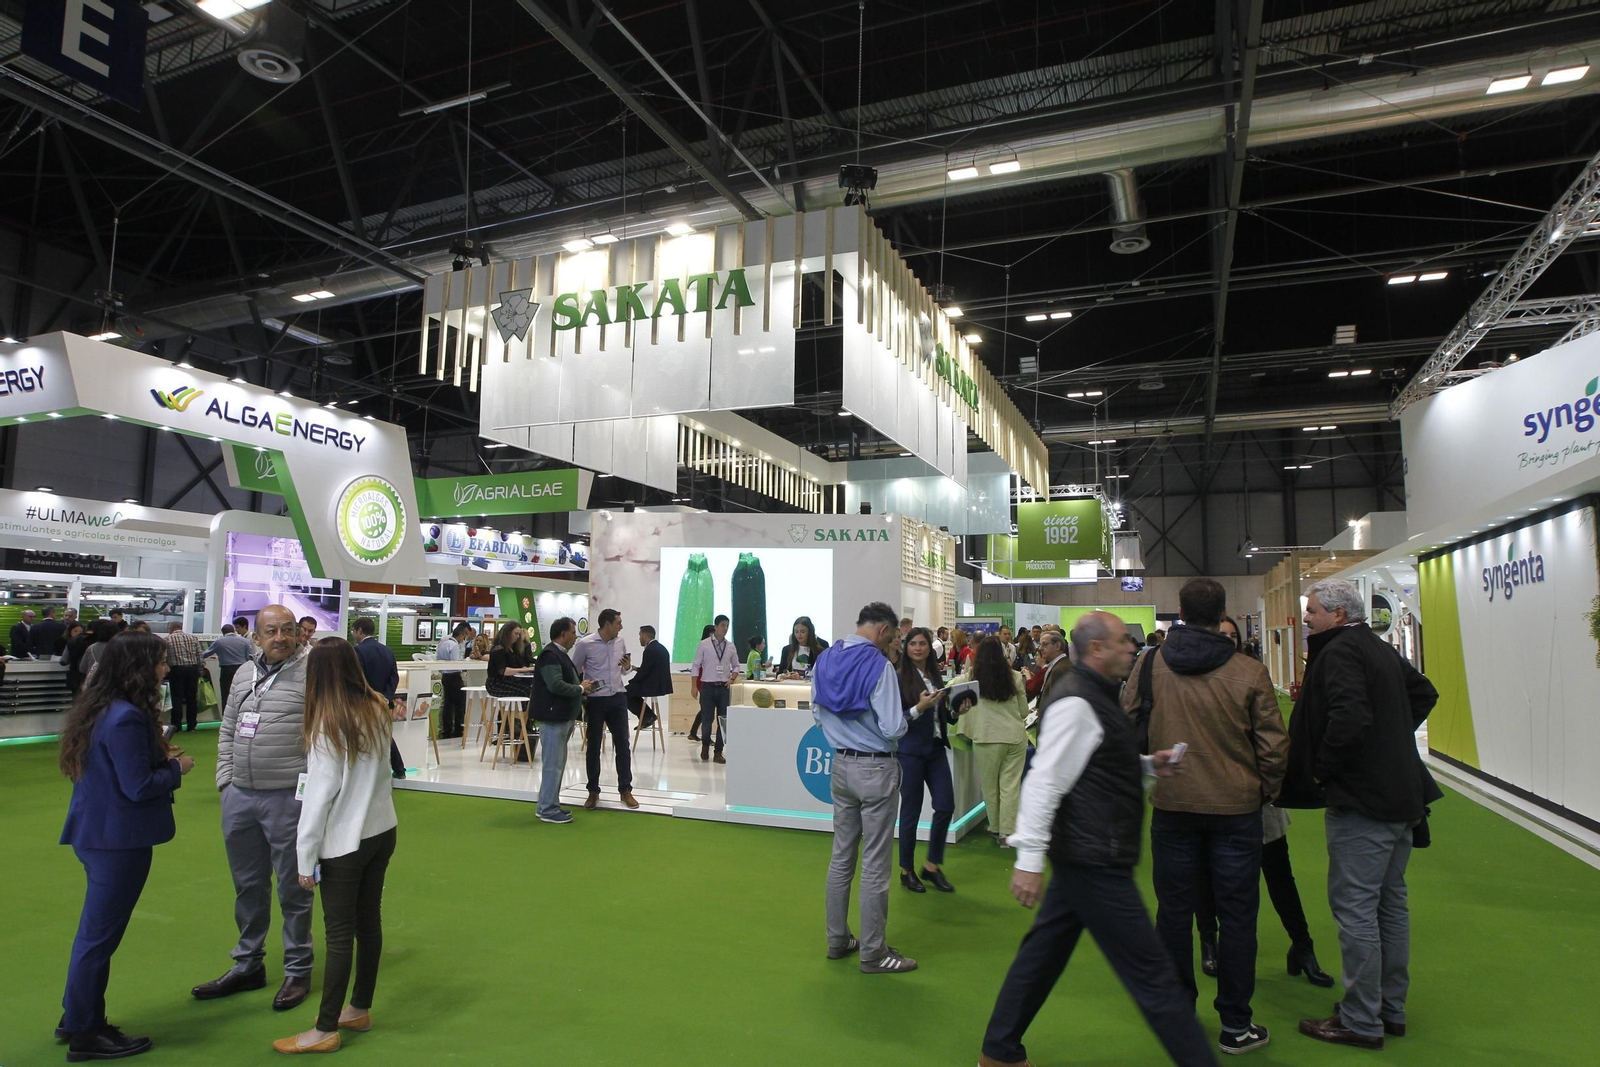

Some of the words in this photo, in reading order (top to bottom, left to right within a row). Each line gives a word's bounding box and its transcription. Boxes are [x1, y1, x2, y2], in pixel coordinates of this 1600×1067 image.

[61, 0, 115, 78] E
[552, 268, 756, 331] SAKATA
[205, 397, 366, 453] ALGAENERGY
[1561, 440, 1594, 464] plant
[475, 482, 563, 501] AGRIALGAE
[351, 492, 389, 518] MICROALGAS
[361, 509, 386, 530] 100%
[1043, 514, 1079, 526] since
[113, 533, 125, 542] de
[127, 535, 177, 547] microalgas
[360, 528, 393, 549] NATURAL
[813, 528, 890, 542] SAKATA
[1044, 526, 1079, 545] 1992
[469, 537, 521, 556] EFABIND
[23, 557, 73, 568] Restaurante
[74, 561, 91, 569] Fast
[92, 563, 113, 571] Good
[1483, 550, 1545, 602] syngenta
[805, 747, 834, 775] Bi
